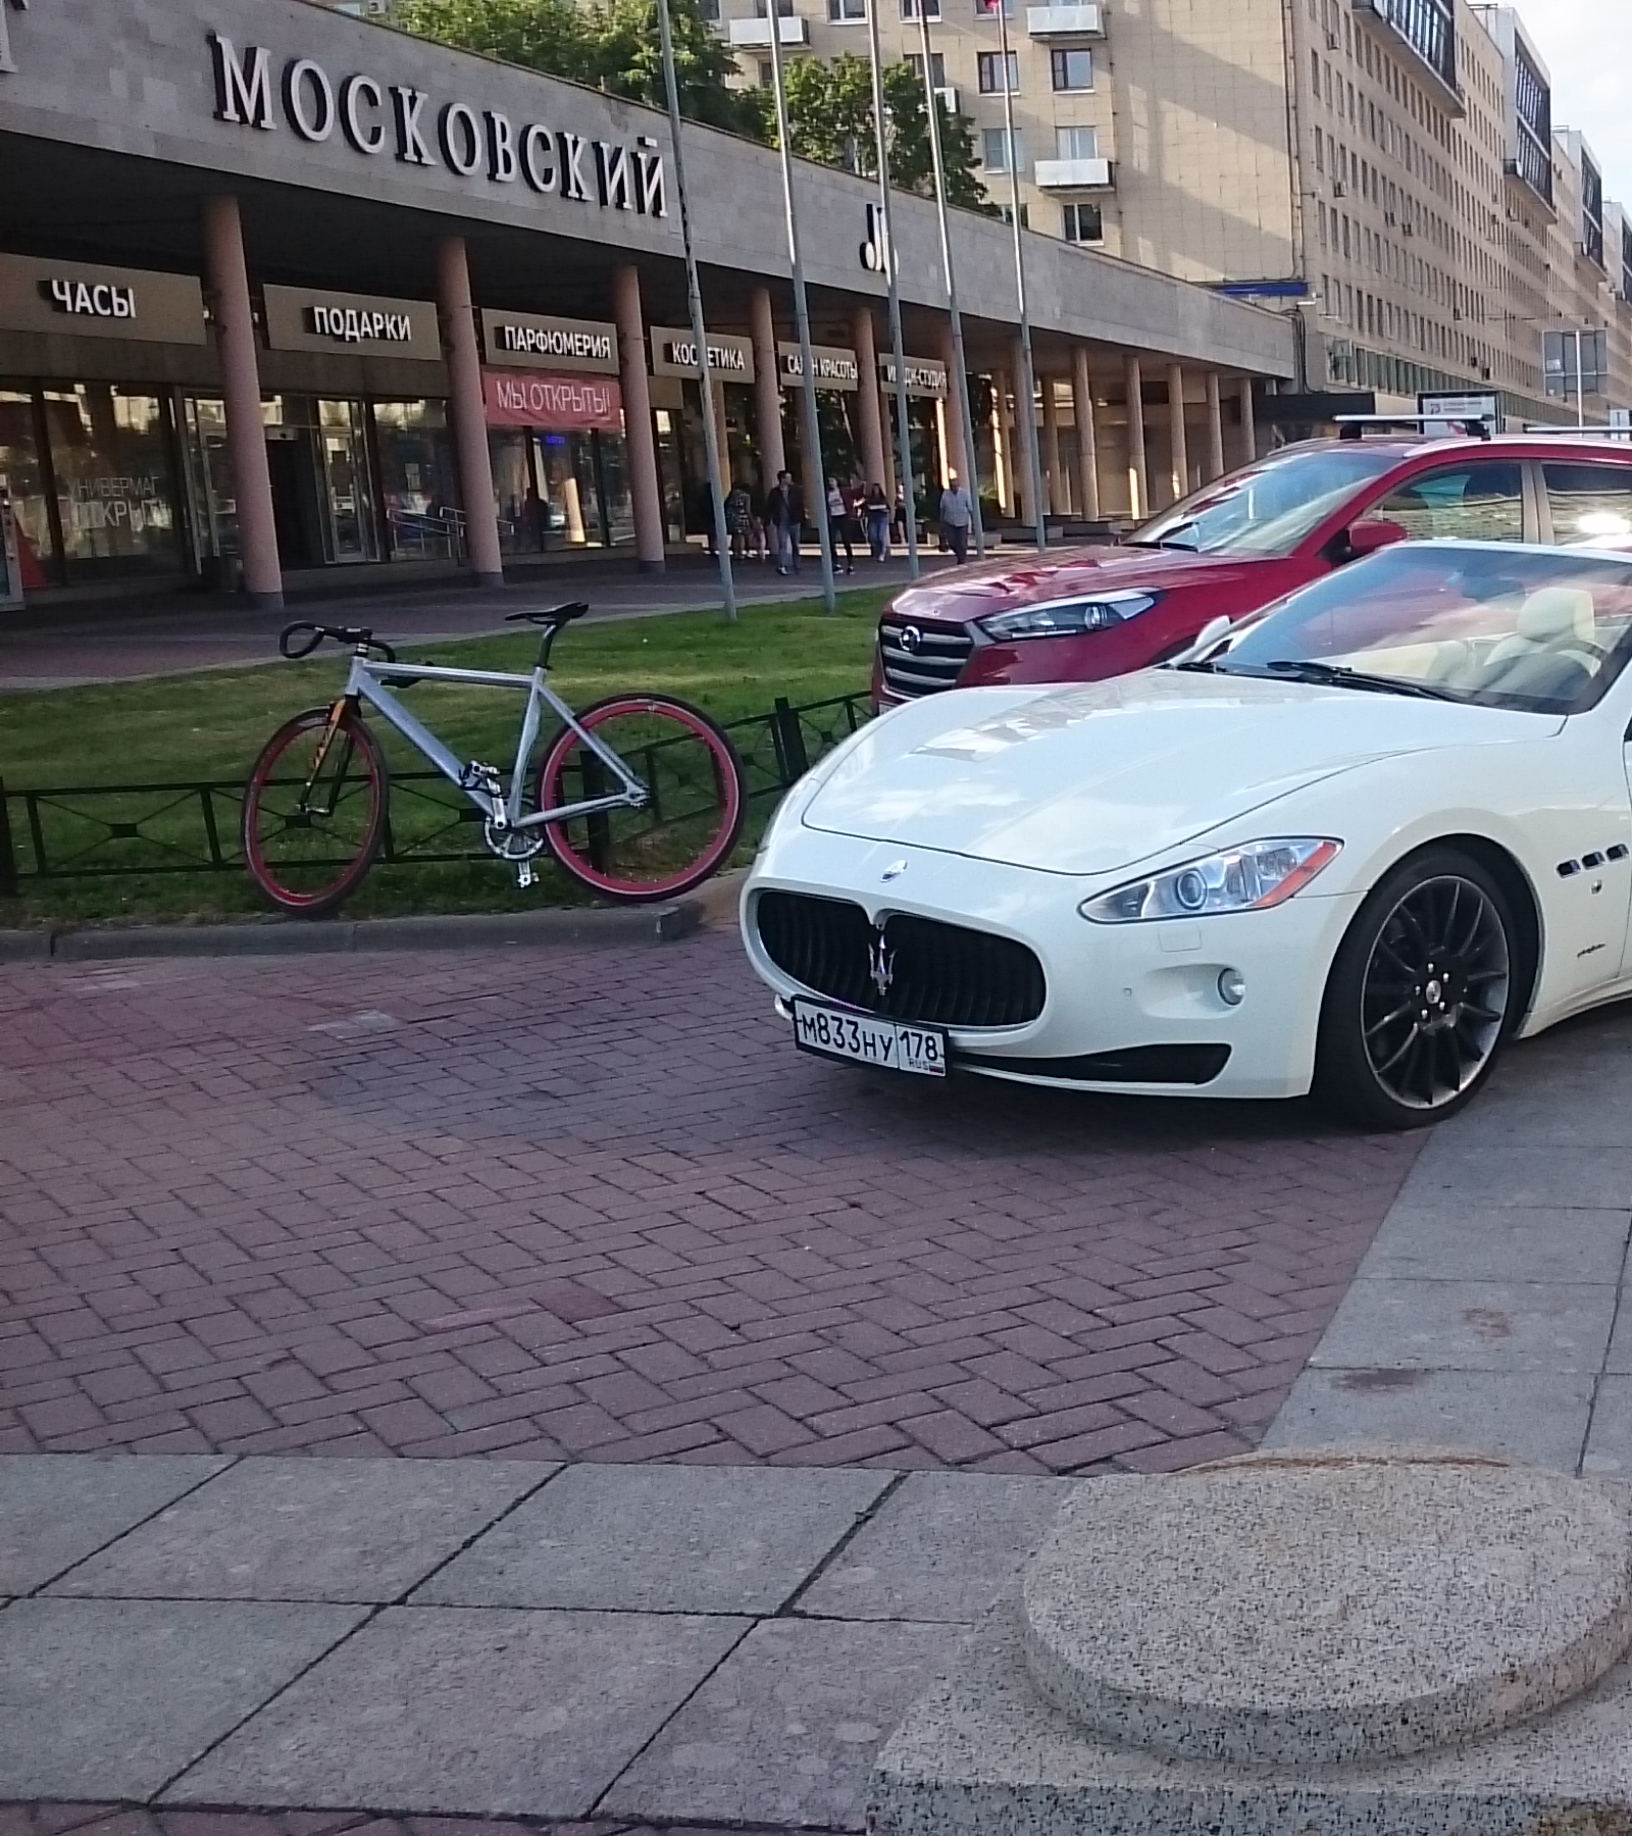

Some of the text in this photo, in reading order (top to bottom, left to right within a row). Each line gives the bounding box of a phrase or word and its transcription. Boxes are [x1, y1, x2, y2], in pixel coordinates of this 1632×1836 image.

[208, 32, 669, 218] МОСКОВСКИЙ
[51, 278, 137, 319] ЧАСЫ
[313, 306, 412, 342] ПОДАРКИ
[504, 325, 612, 359] ПАРФЮМЕРИЯ
[671, 341, 746, 370] КОСЕТИКА
[496, 380, 528, 410] МЫ
[899, 1030, 938, 1061] 178
[908, 1057, 929, 1072] RUS
